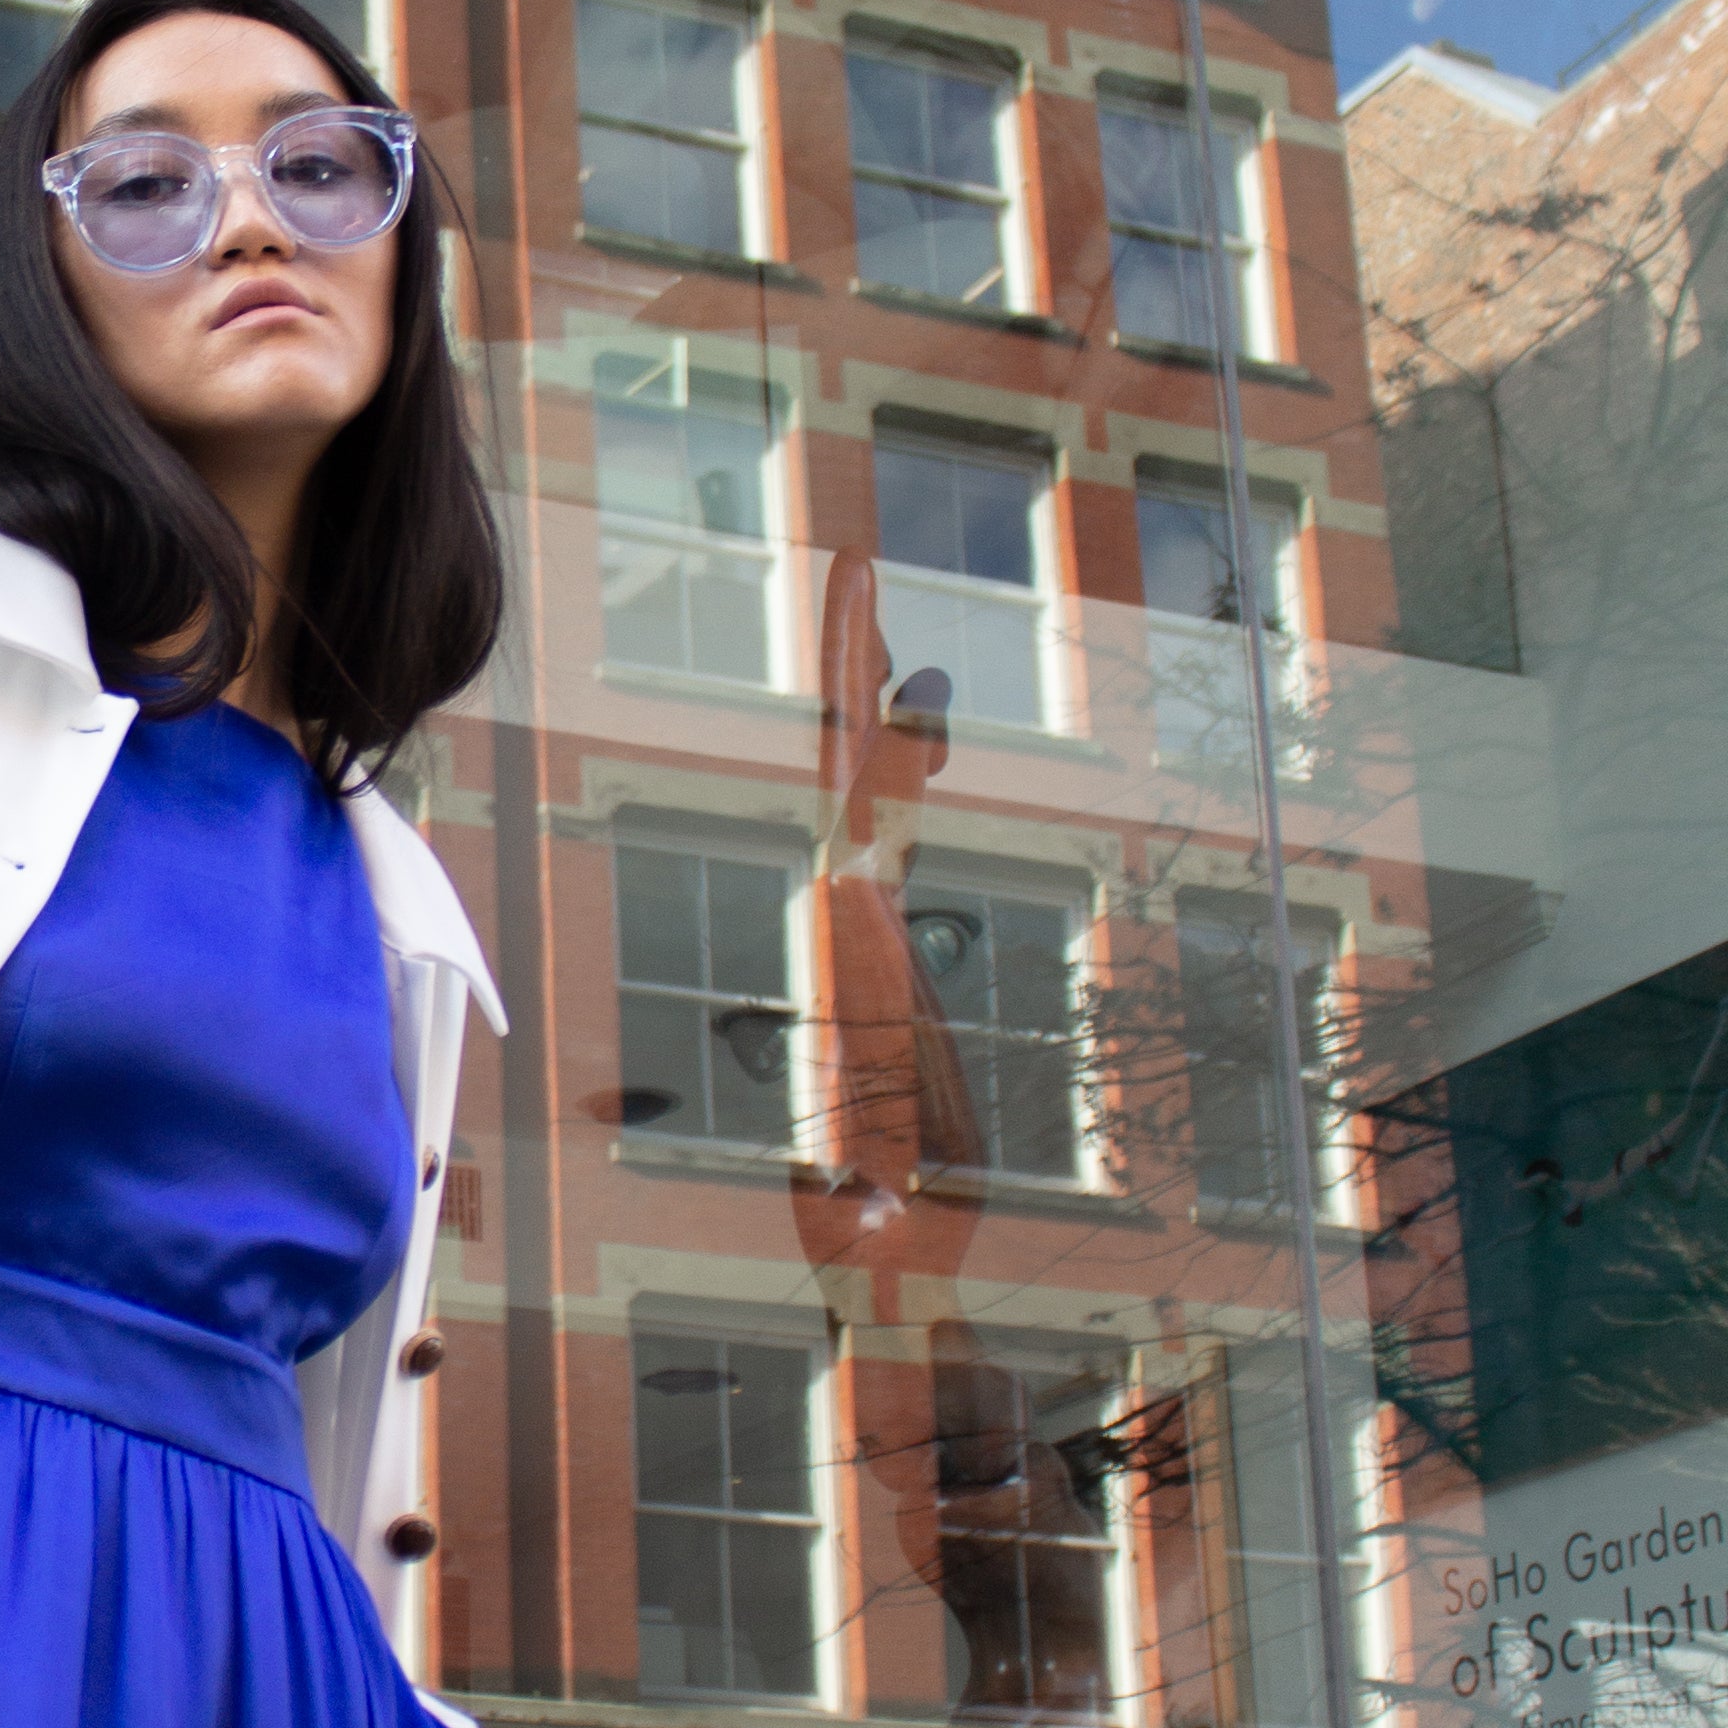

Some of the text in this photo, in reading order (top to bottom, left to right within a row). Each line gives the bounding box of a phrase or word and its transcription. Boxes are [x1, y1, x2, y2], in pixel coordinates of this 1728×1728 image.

[1443, 1505, 1725, 1617] SoHo Garden
[1450, 1620, 1501, 1699] of
